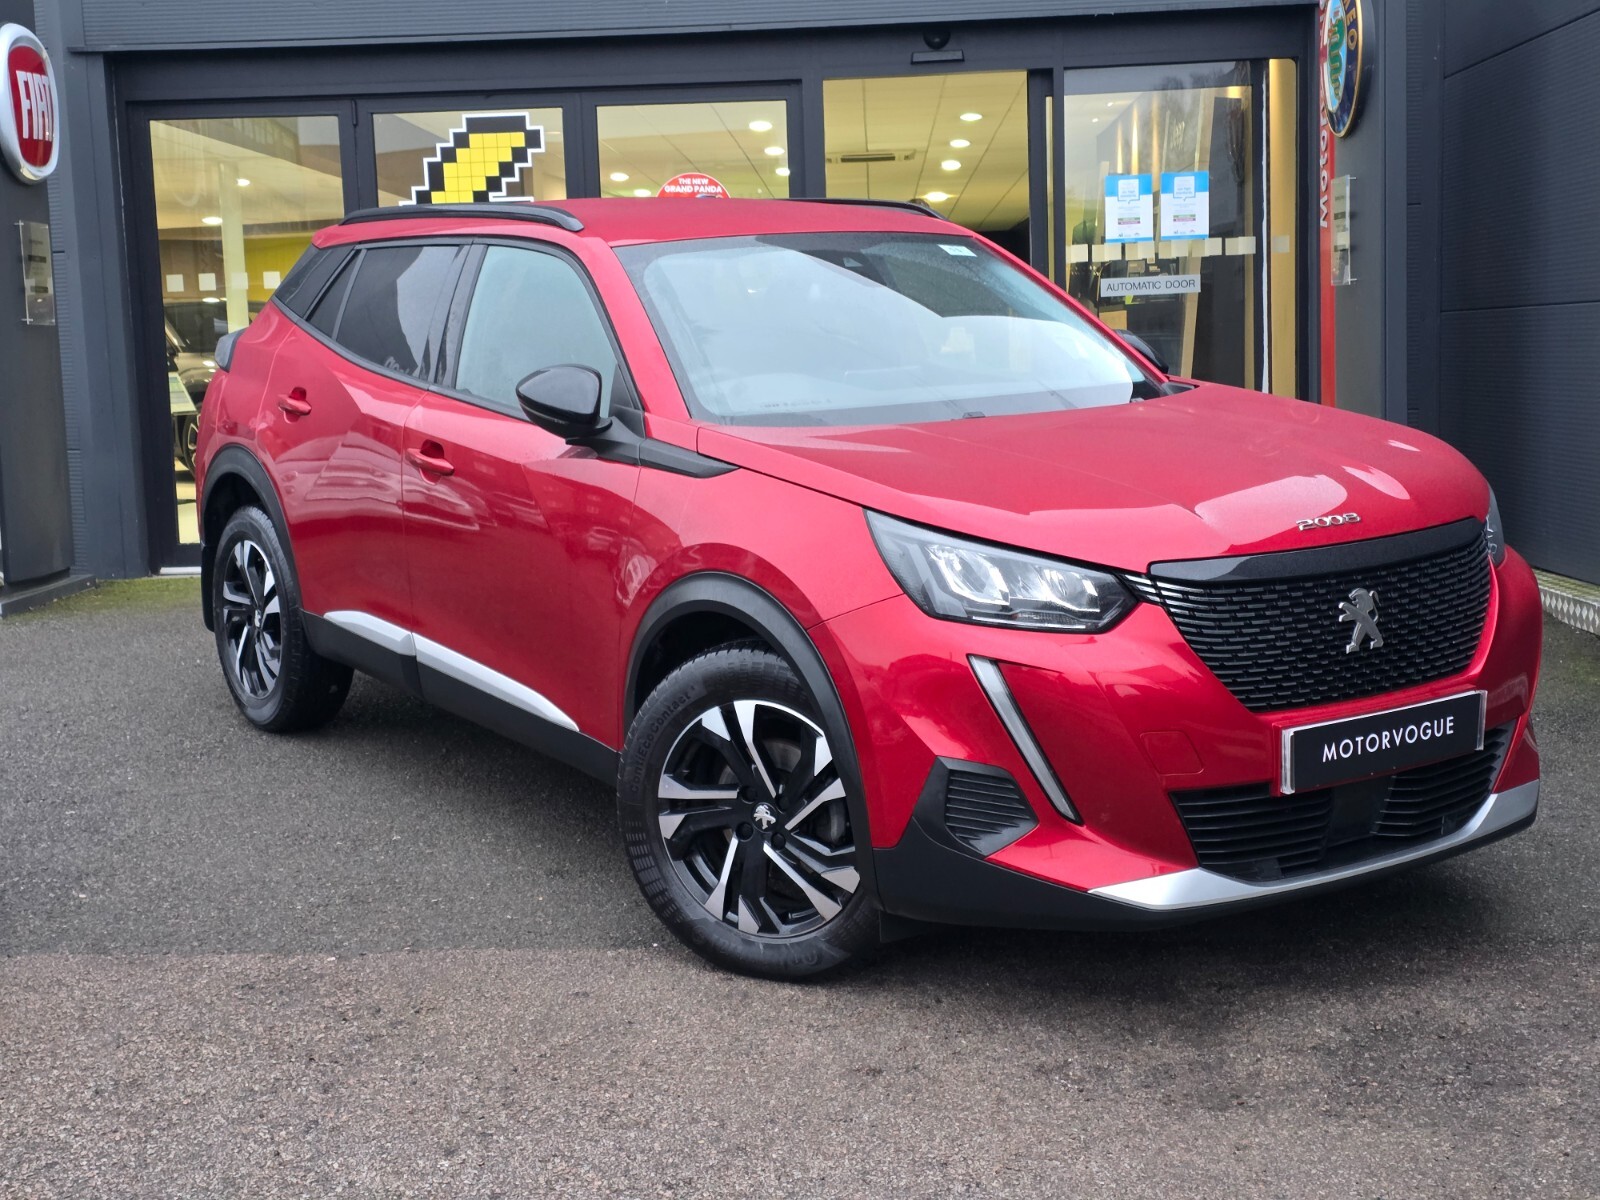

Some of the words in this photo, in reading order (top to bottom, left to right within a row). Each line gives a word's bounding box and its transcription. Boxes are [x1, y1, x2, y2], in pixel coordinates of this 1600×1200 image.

[16, 70, 52, 141] FIAT
[664, 185, 693, 193] GRAND
[694, 185, 722, 193] PANDA
[1106, 281, 1161, 292] AUTOMATIC
[1165, 279, 1196, 289] DOOR
[1295, 512, 1361, 531] 2008
[1322, 716, 1454, 763] MOTORVOGUE
